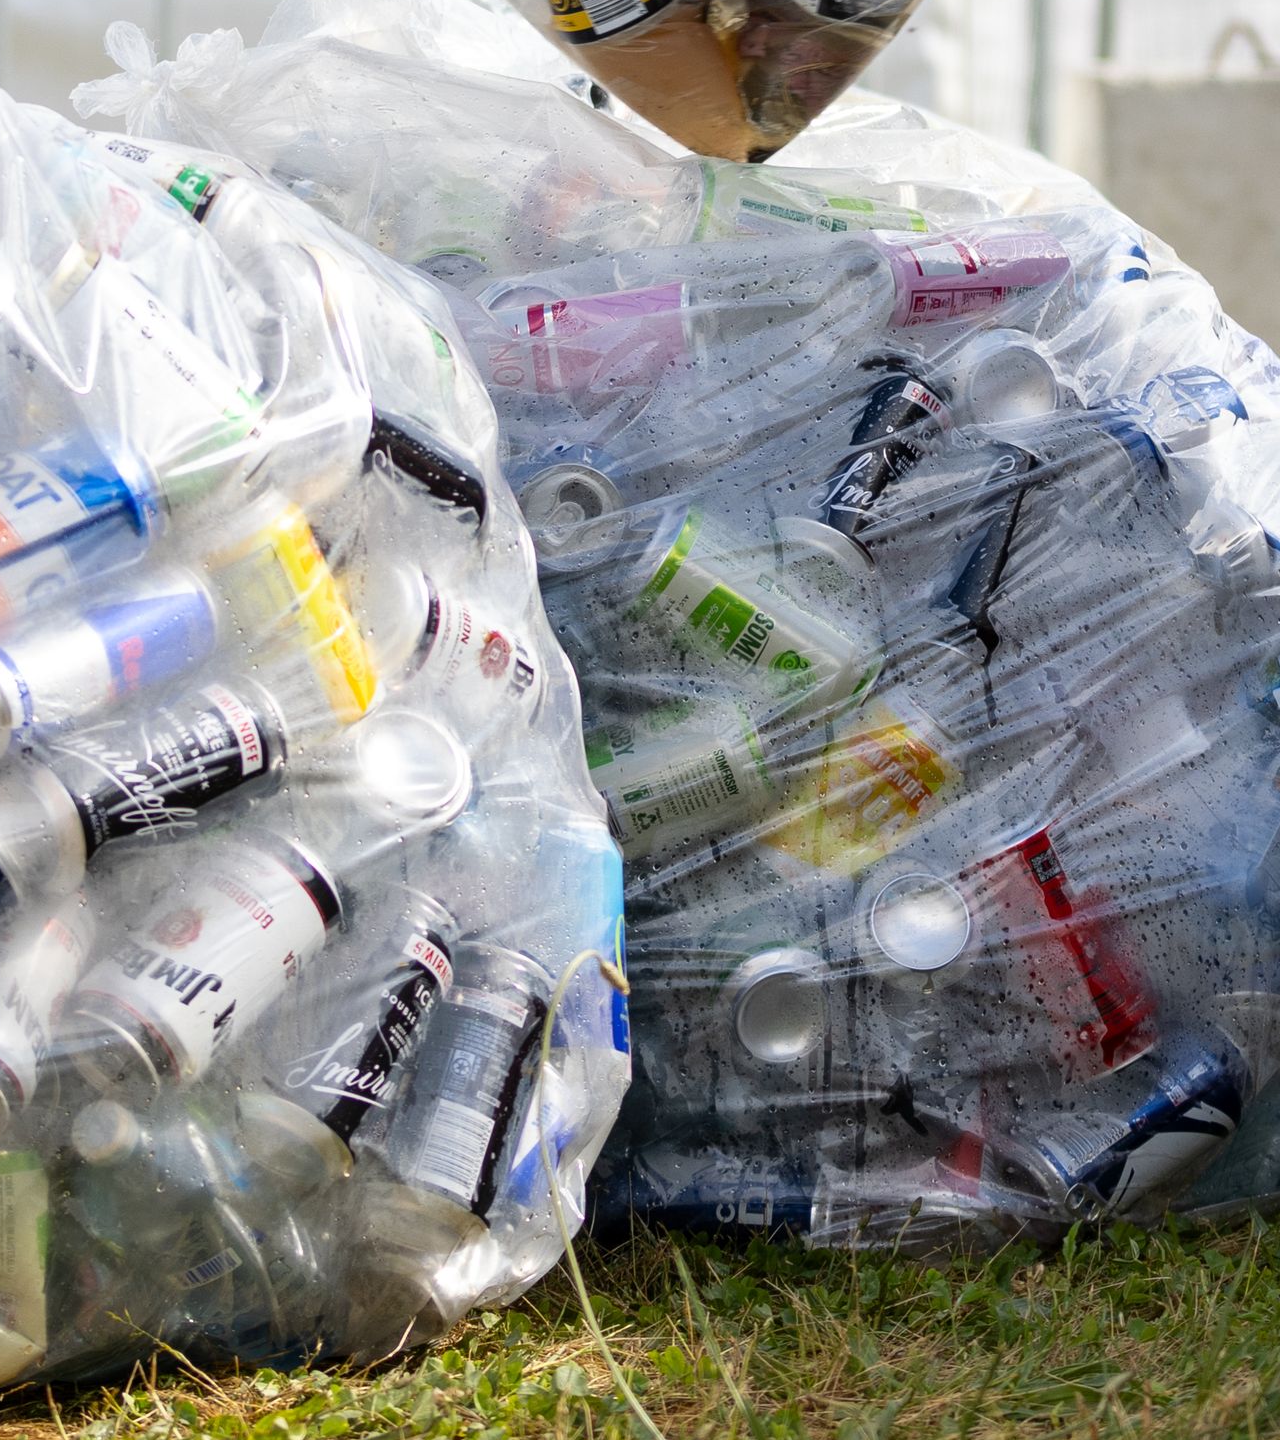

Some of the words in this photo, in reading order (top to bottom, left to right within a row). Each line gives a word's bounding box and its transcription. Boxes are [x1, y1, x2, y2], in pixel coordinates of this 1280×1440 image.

[212, 688, 263, 764] SMIRNOFF
[714, 748, 739, 796] SOMERSBY
[152, 957, 223, 1006] JIM
[415, 984, 435, 1013] ICE
[380, 989, 417, 1026] DOUBLE
